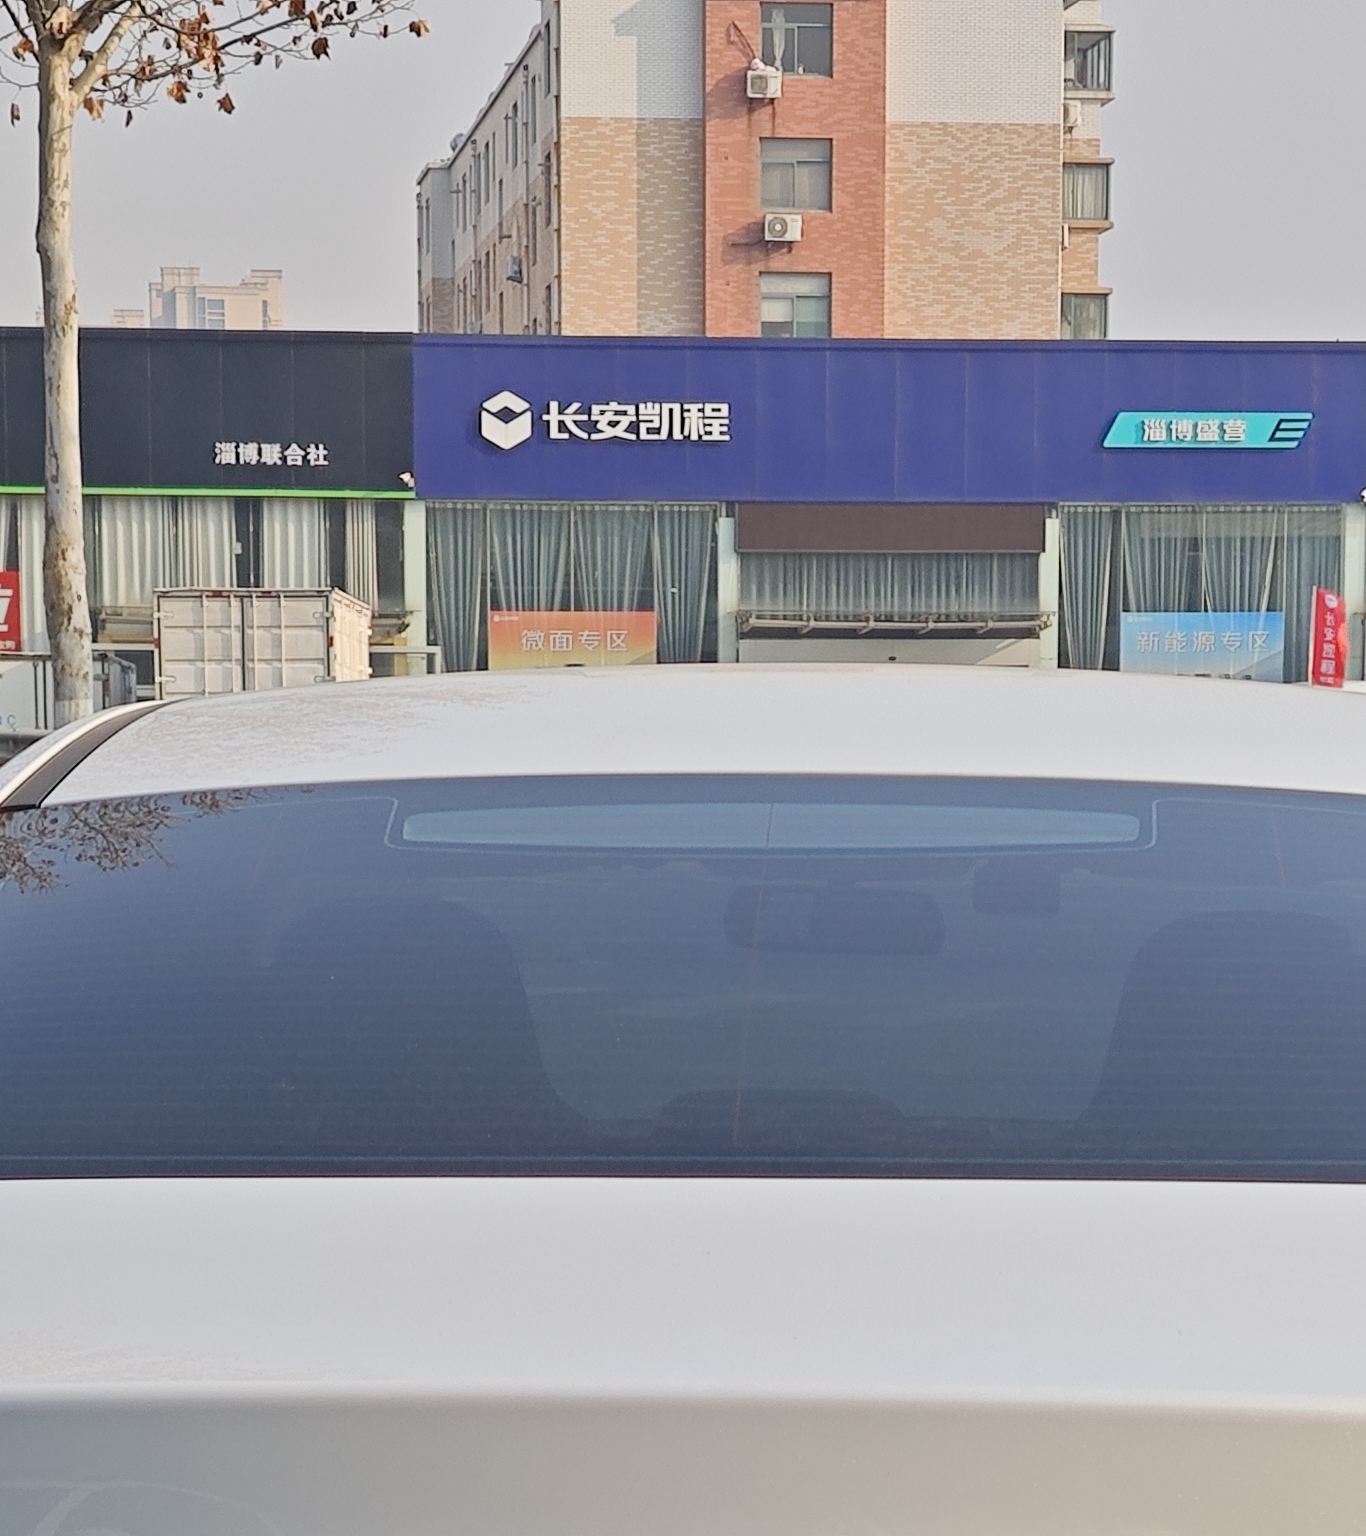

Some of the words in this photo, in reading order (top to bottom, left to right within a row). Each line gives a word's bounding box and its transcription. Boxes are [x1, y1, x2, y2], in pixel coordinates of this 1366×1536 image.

[542, 401, 732, 442] 长安凯程
[1143, 418, 1247, 442] 淄博盛营
[213, 440, 329, 467] 淄博联合社
[521, 629, 629, 652] 微面专区
[1137, 630, 1271, 653] 新能源专区
